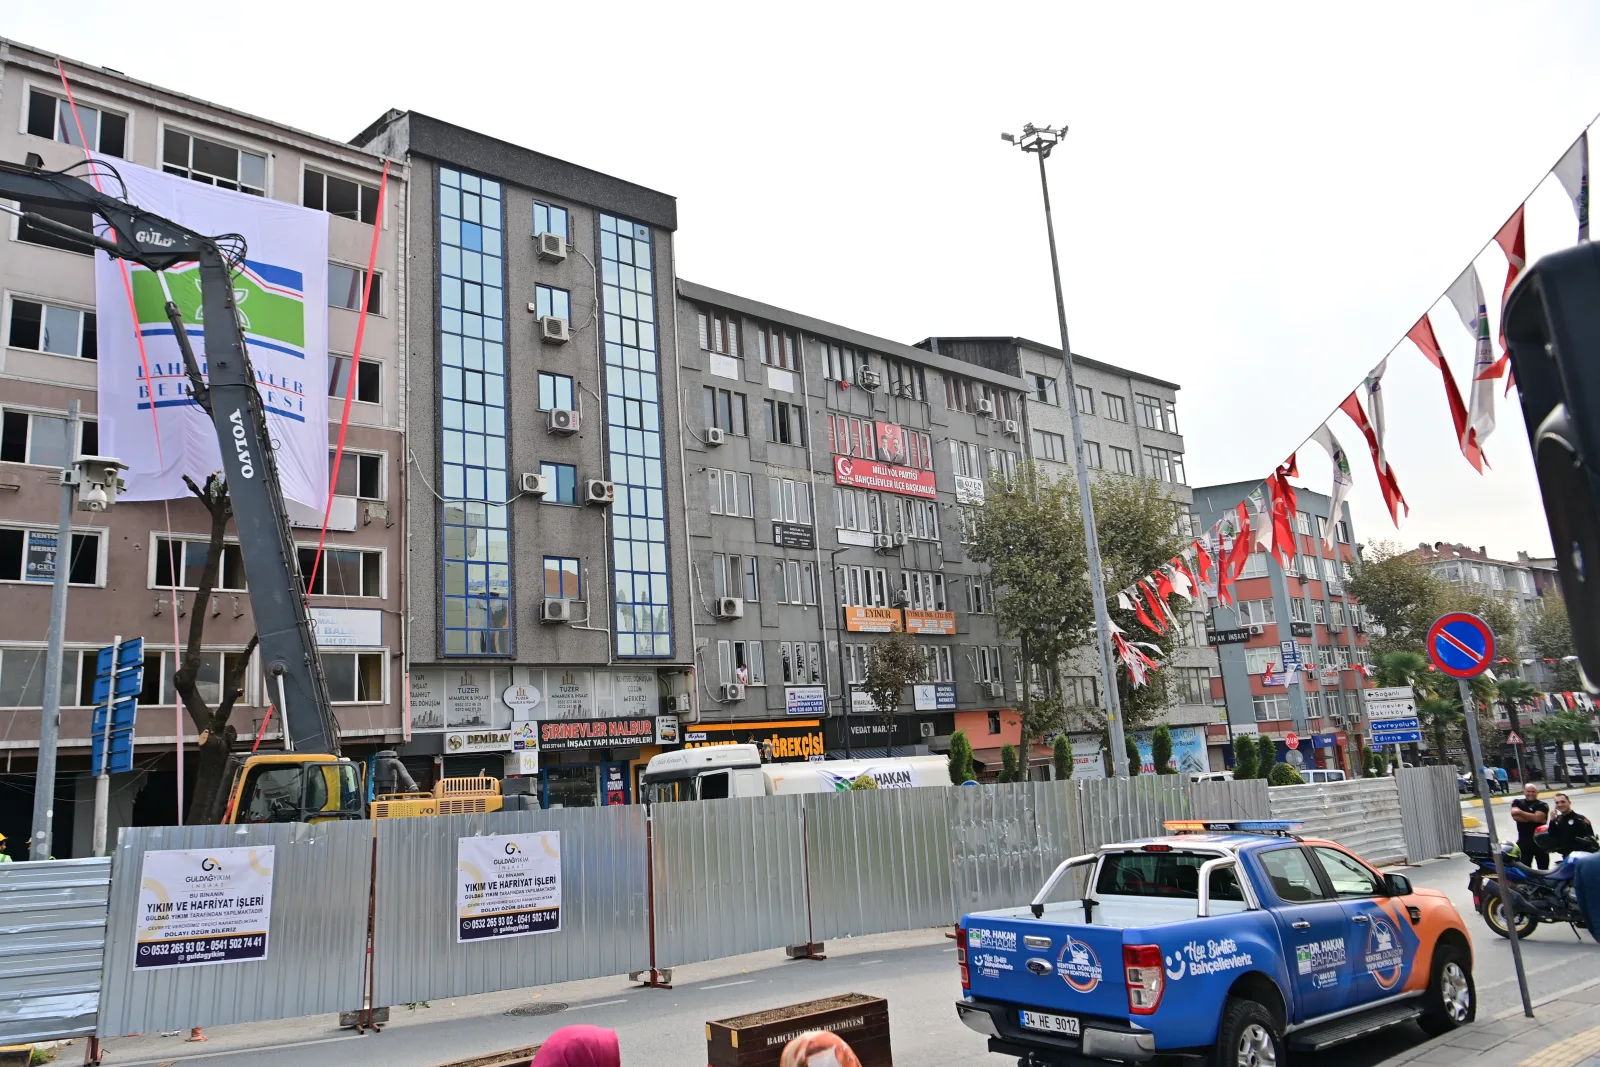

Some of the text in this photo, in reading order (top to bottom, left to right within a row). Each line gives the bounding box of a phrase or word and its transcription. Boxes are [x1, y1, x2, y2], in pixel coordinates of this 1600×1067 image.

[229, 408, 254, 479] VOLVO
[872, 465, 918, 480] MİLLİ YOL PARTİSİ
[855, 475, 936, 495] BAHÇELİEVLER İLÇE BAŞKANLIĞI
[467, 732, 510, 744] DEMİRAY
[542, 722, 607, 741] ŞİRİNEVLER
[609, 720, 652, 736] NALBUR
[850, 725, 898, 734] VEDAT MARET
[567, 739, 591, 748] İNŞAAT
[609, 735, 653, 745] MALZEMELERİ
[874, 770, 911, 786] HAKAN
[465, 874, 556, 892] YIKIM VE HAFRİYAT İŞLERİ
[147, 895, 264, 912] YIKIM VE HAFRİYAT İŞLERİ
[472, 920, 485, 929] 0532
[487, 919, 497, 927] 265
[498, 917, 506, 926] 93
[518, 914, 530, 924] 0541
[532, 913, 542, 921] 502
[551, 911, 556, 919] 41
[981, 929, 1016, 940] DR. HAKAN
[981, 938, 1016, 948] BAHADIR
[151, 937, 262, 956] 0532 265 93 02 0541 502 74 41
[1184, 939, 1237, 962] Hep Birlikte
[1309, 937, 1345, 954] DR. HAKAN
[186, 951, 225, 961] guldagyikim
[1311, 949, 1346, 966] BAHADIR
[1025, 1013, 1035, 1025] 34
[1039, 1015, 1050, 1028] HE
[1055, 1018, 1077, 1032] 9012
